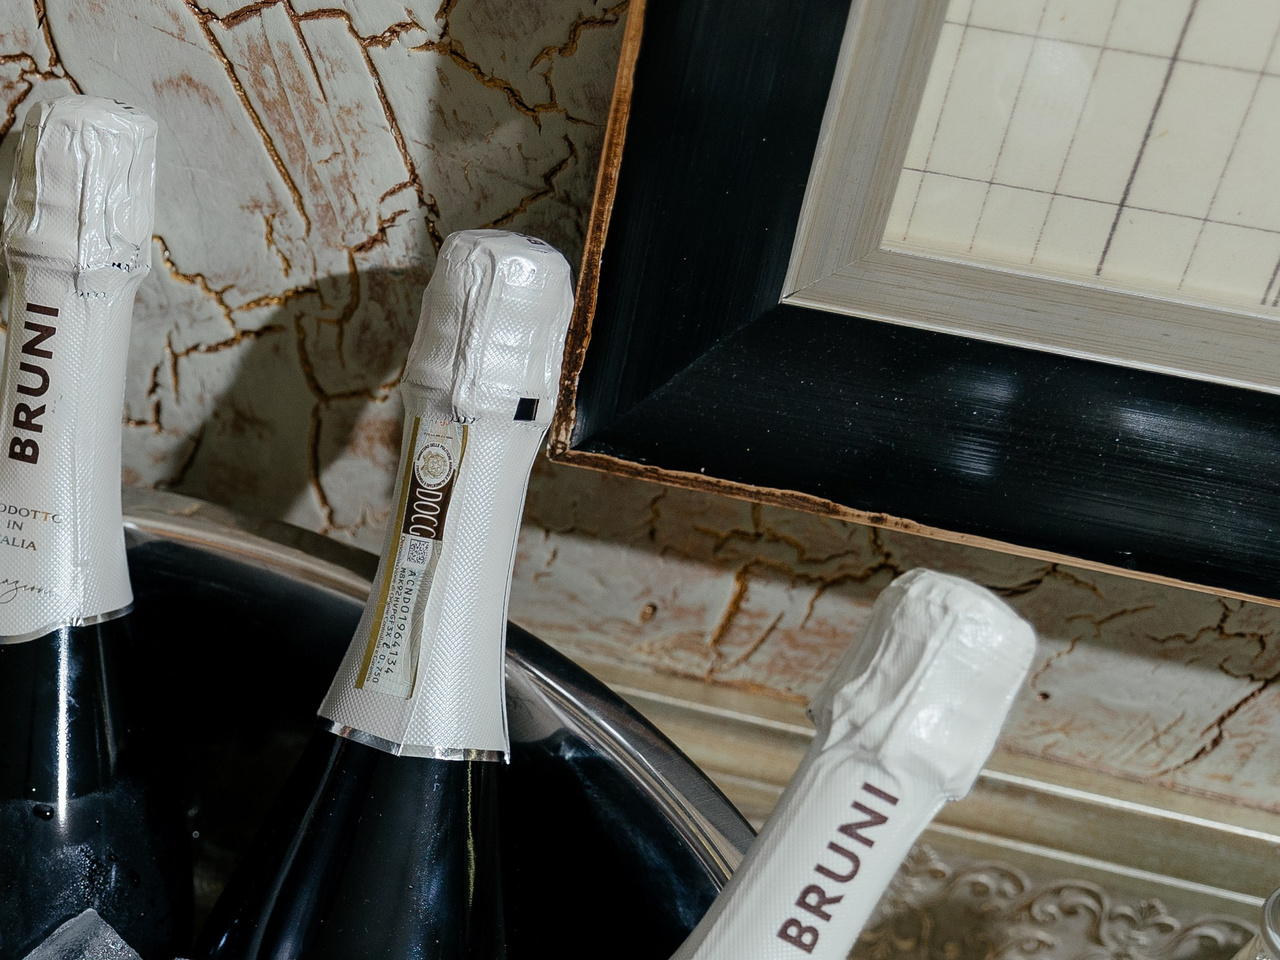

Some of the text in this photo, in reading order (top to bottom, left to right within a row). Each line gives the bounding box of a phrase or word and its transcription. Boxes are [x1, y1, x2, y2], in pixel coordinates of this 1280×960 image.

[8, 302, 60, 465] BRUNI
[6, 519, 24, 532] IN
[409, 488, 443, 539] DOCG
[776, 781, 899, 955] BRUNI
